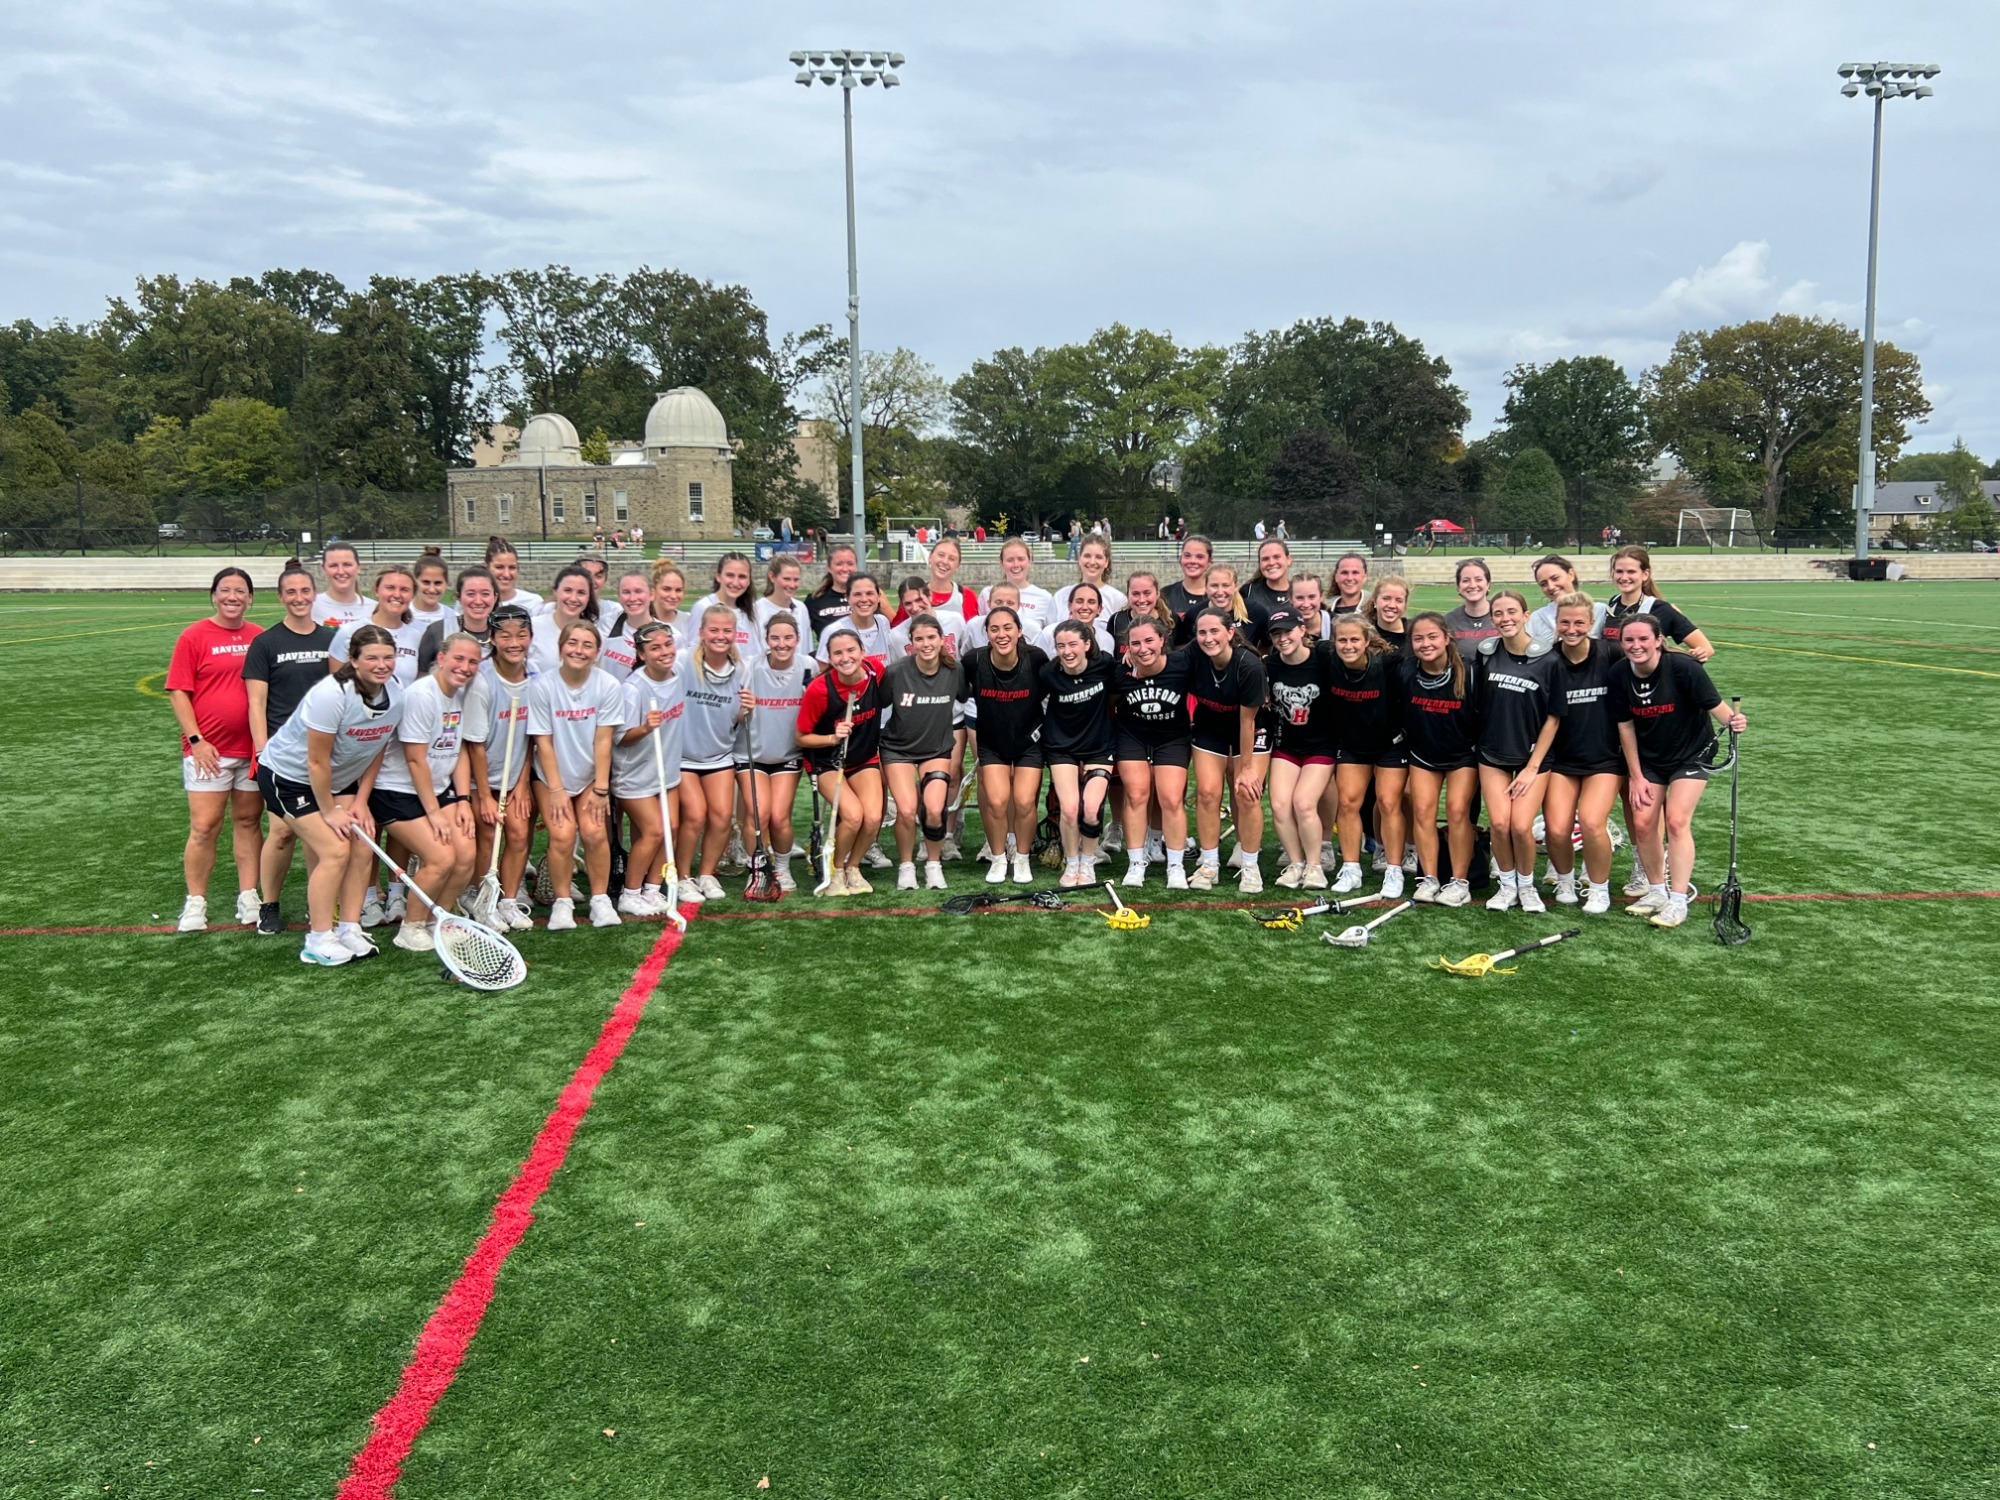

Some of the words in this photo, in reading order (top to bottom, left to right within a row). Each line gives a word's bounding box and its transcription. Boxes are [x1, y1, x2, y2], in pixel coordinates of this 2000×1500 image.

[212, 644, 250, 656] HAVERF
[277, 651, 330, 663] HAVERFOR
[1488, 672, 1540, 691] HAVERFORD
[686, 690, 732, 704] HAVERFORD
[980, 689, 1029, 699] HAVERFORD
[1059, 681, 1104, 703] HAVERFORD
[1332, 687, 1379, 699] HAVERFORD
[1566, 686, 1608, 699] VERFORD
[1412, 696, 1461, 709] HAVERFORD
[555, 706, 596, 718] HAVERFOR
[1291, 708, 1309, 724] H
